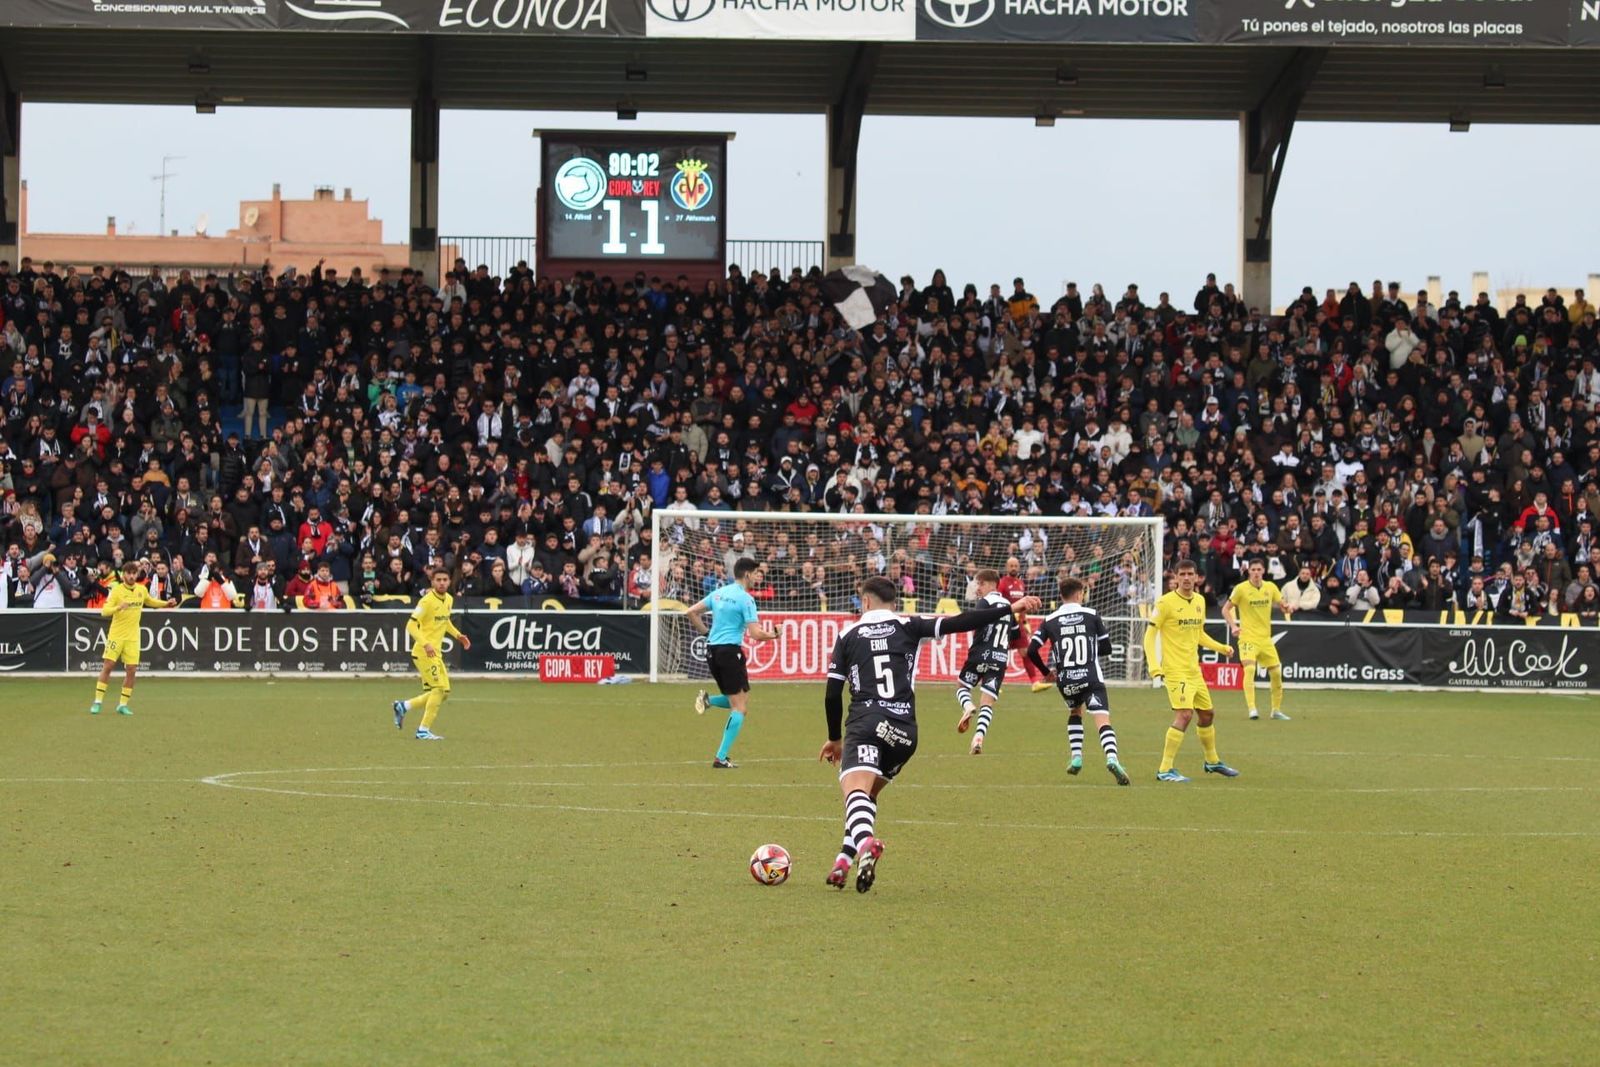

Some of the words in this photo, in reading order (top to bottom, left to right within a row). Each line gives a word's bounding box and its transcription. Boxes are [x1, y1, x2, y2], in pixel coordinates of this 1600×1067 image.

[439, 0, 607, 30] ECONOA
[1004, 0, 1092, 16] HACHA
[1098, 0, 1188, 17] MOTOR
[1242, 19, 1260, 32] Tú
[1263, 21, 1308, 35] pones
[1311, 20, 1325, 33] el
[1327, 20, 1379, 36] tejado,
[1382, 22, 1446, 34] nosotros
[1448, 22, 1470, 34] las
[1473, 22, 1523, 37] placas
[608, 152, 659, 177] 90:02
[608, 180, 632, 196] COPA
[644, 180, 661, 196] REY
[602, 199, 627, 254] 1
[640, 199, 665, 254] 1
[74, 618, 199, 652] SADÓN
[214, 627, 252, 652] DE
[265, 626, 319, 652] LOS
[993, 623, 1009, 650] 14
[781, 618, 851, 676] COP
[870, 638, 888, 652] ERIK
[1061, 635, 1087, 667] 20
[430, 665, 438, 677] 2
[545, 659, 571, 678] COPA
[584, 659, 603, 678] REY
[873, 654, 895, 699] 5
[1217, 667, 1239, 687] REY
[1361, 664, 1404, 681] Grass
[1179, 681, 1186, 695] 7
[1556, 680, 1588, 688] EVENTOS
